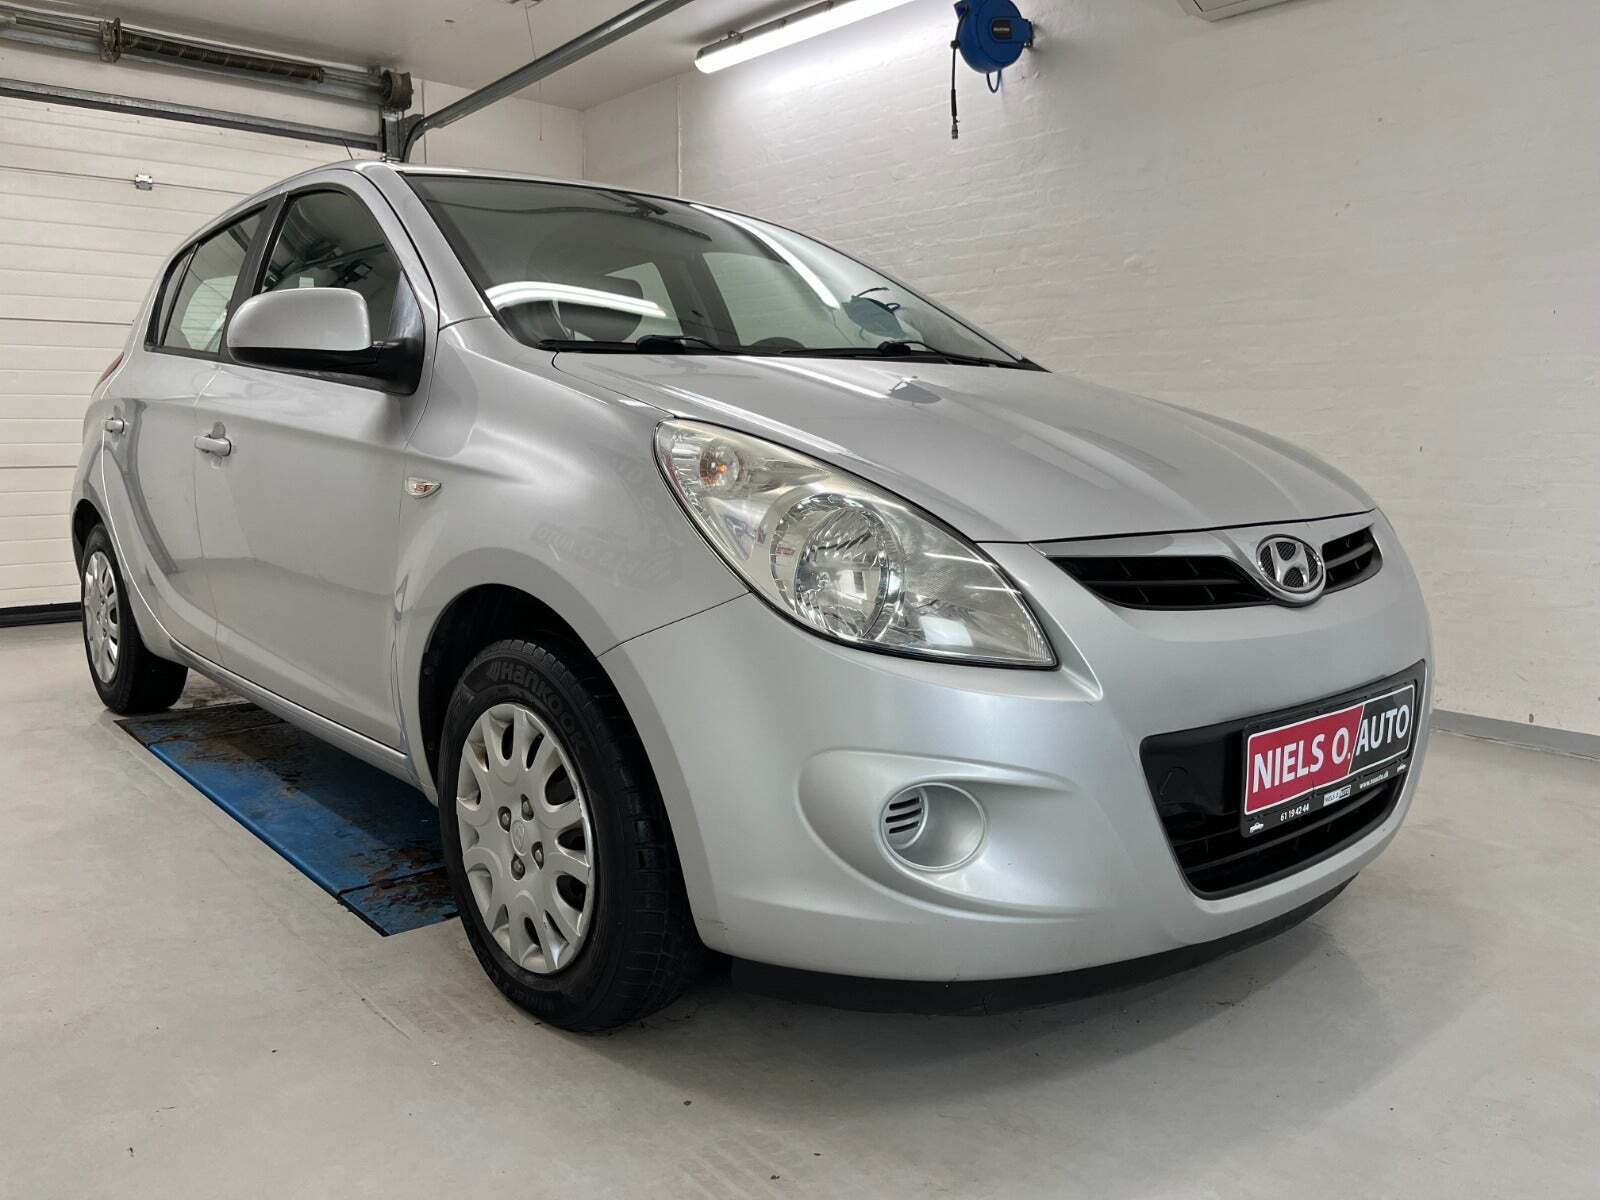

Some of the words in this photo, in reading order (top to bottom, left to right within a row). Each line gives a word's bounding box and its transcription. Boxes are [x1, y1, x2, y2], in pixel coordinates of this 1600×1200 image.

[1252, 733, 1326, 793] NIELS
[1331, 726, 1351, 765] O.
[1355, 703, 1410, 757] AUTO
[1280, 811, 1288, 822] 61
[1295, 805, 1303, 816] 42
[1302, 802, 1310, 813] 44
